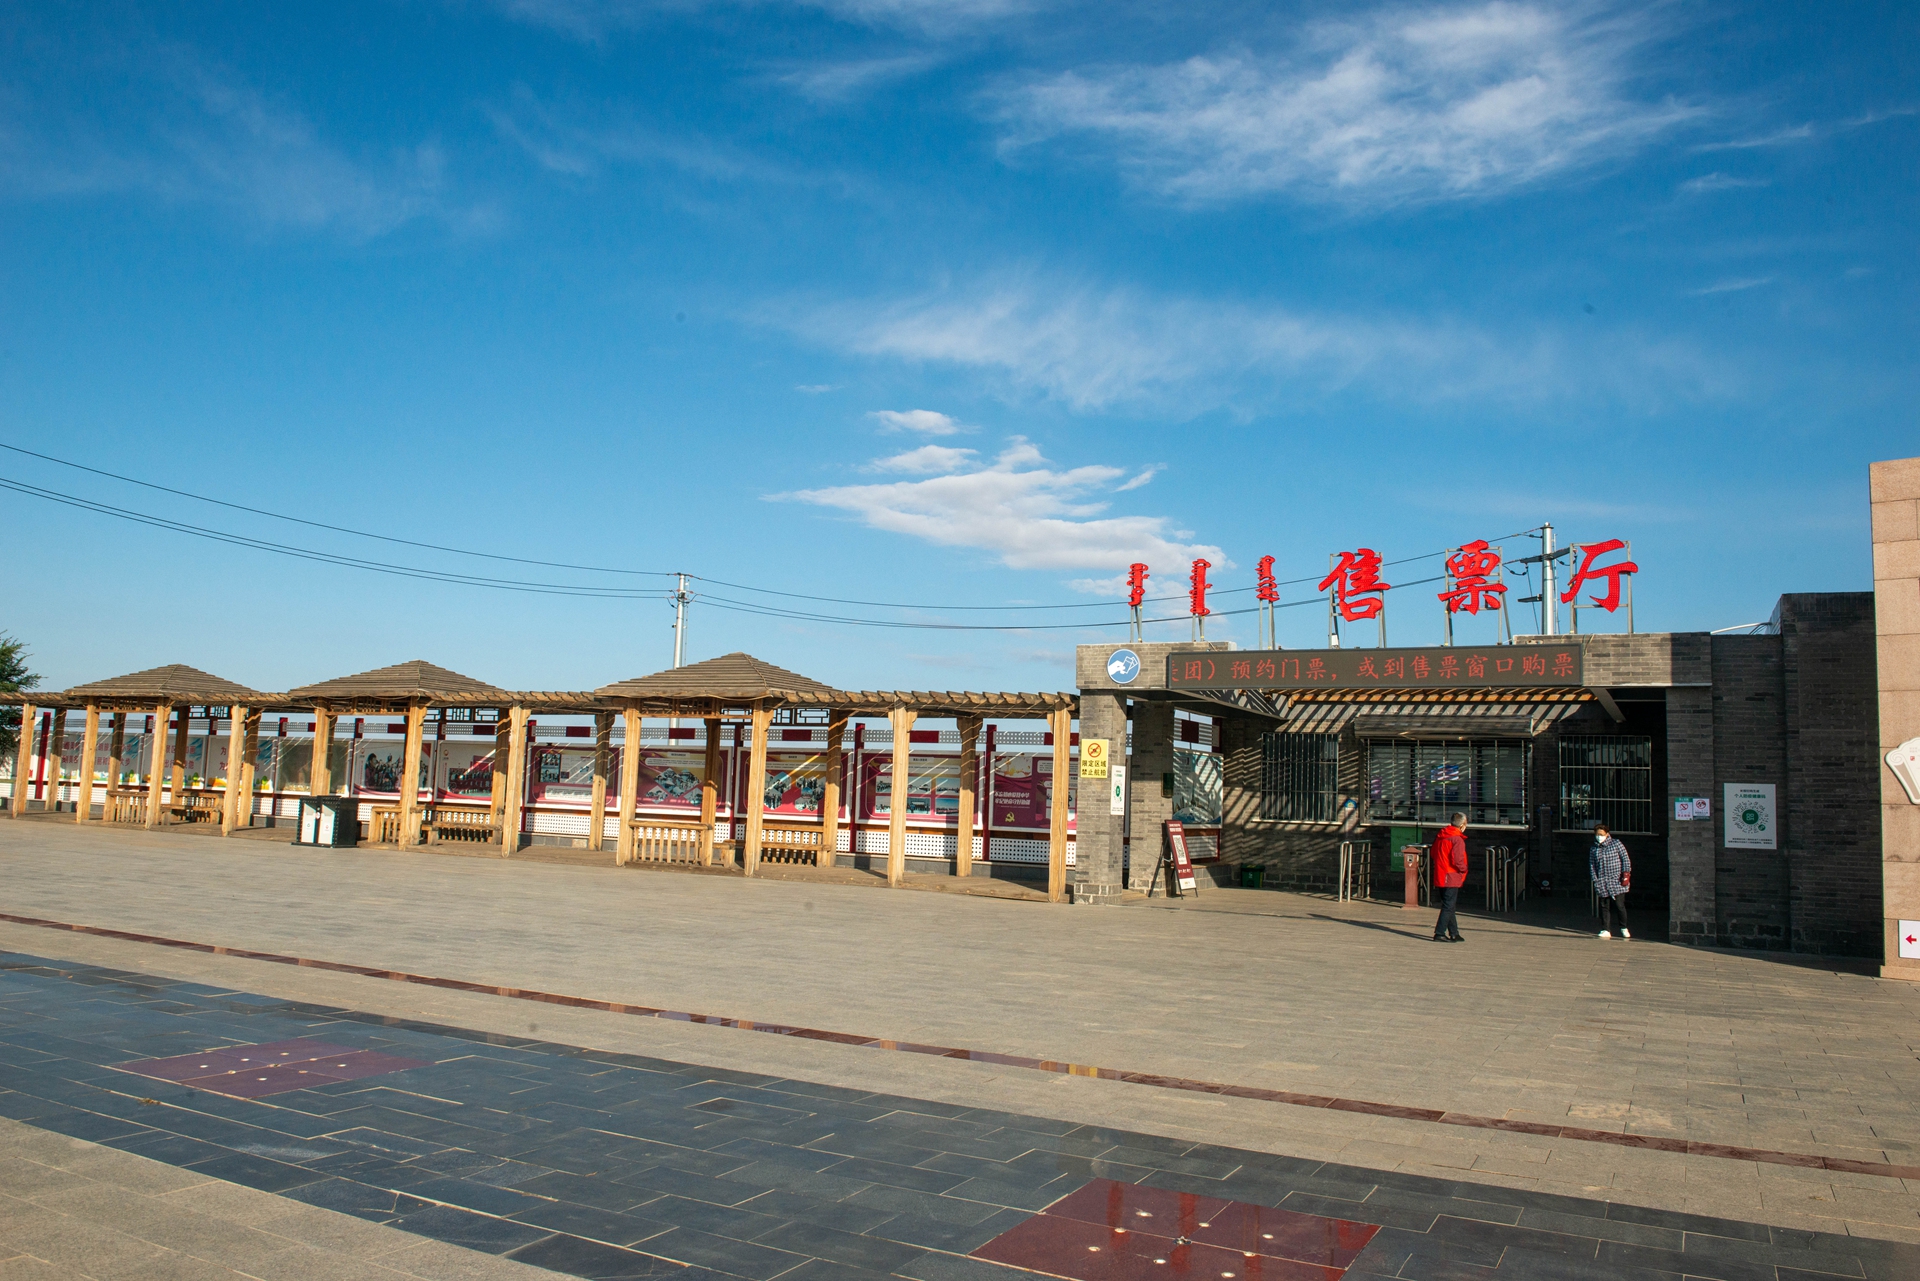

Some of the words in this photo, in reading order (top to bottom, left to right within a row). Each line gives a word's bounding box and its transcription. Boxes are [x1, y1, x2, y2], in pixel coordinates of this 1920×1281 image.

[1319, 538, 1640, 621] 售票厅
[1081, 760, 1107, 768] 限定区域
[1081, 769, 1107, 777] 禁止航拍
